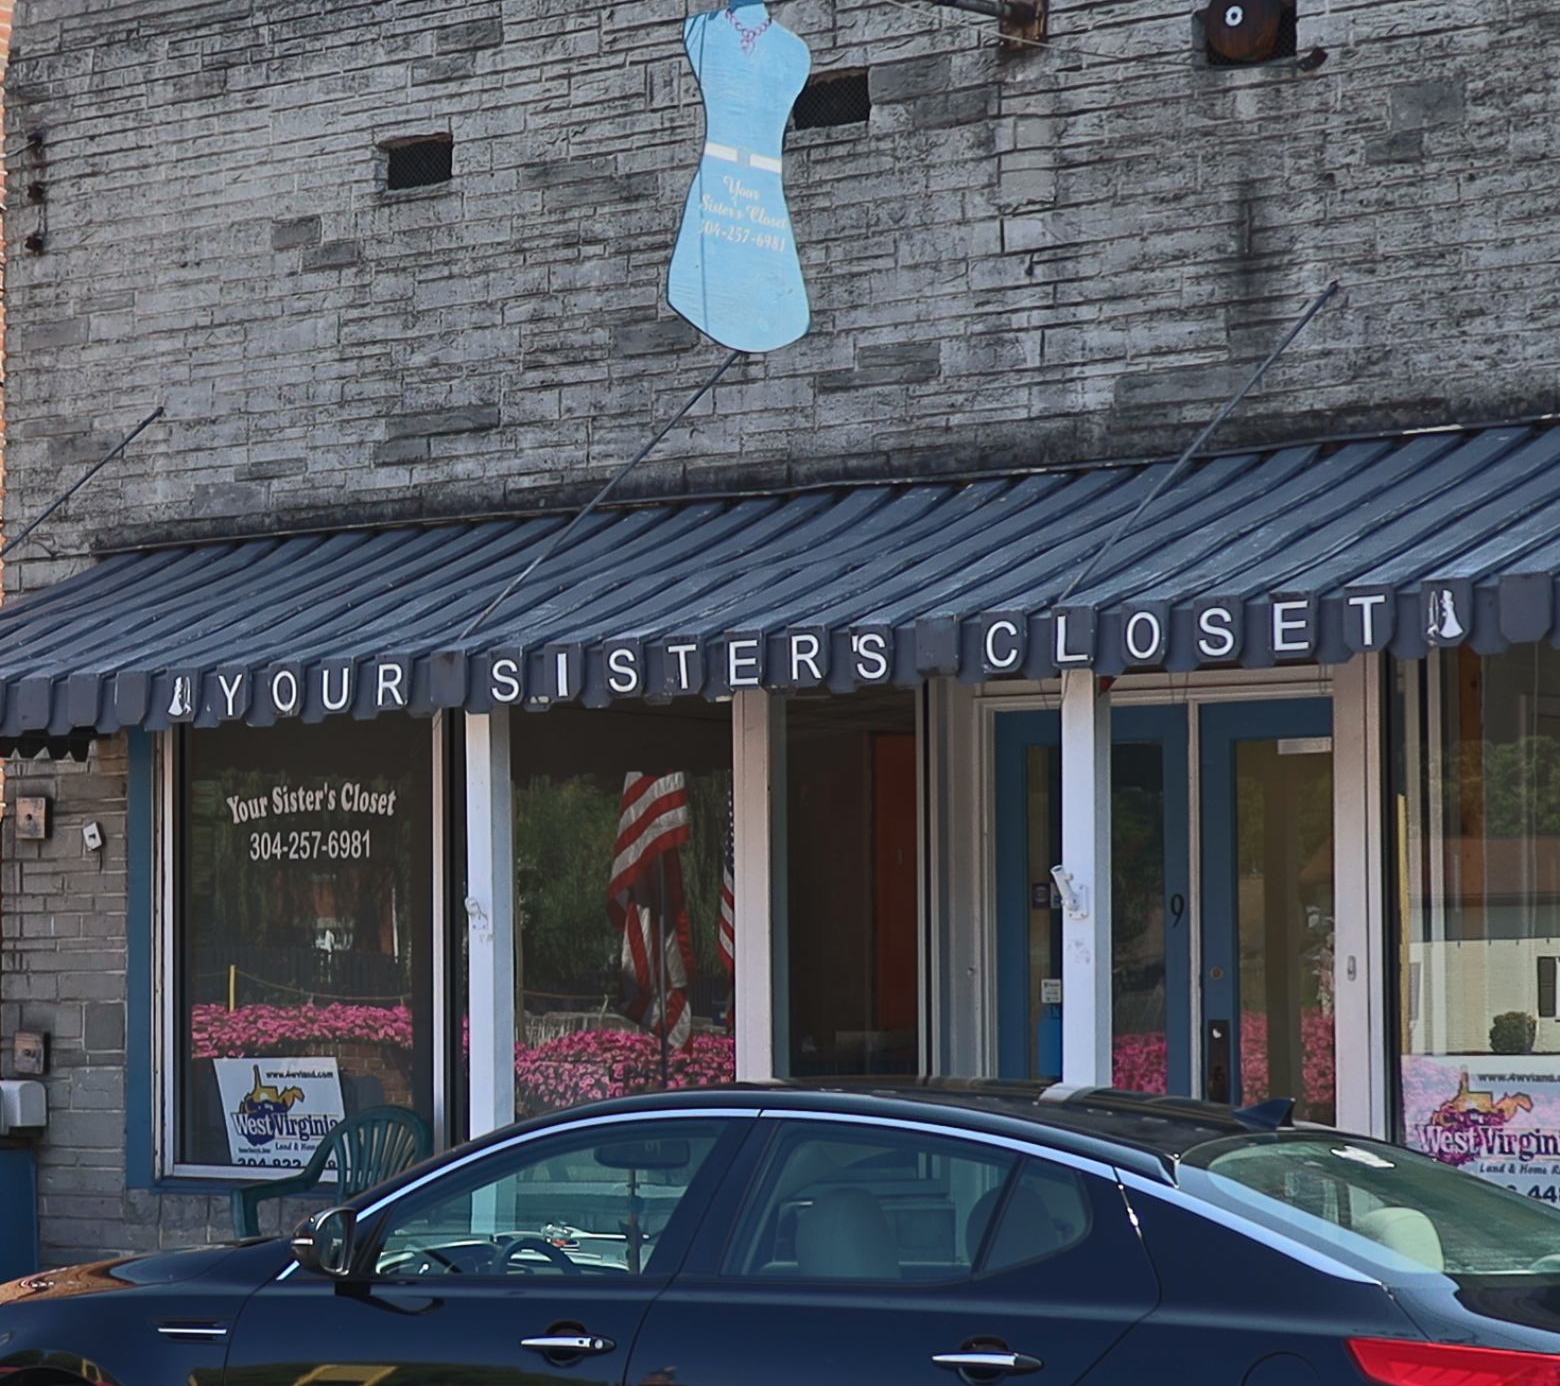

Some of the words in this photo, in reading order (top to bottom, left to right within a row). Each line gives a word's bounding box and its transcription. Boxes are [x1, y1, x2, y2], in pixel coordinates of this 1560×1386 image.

[723, 175, 761, 201] Your
[745, 204, 791, 230] Closet
[218, 663, 405, 717] YOUR
[490, 633, 888, 704] SISTER'S
[985, 593, 1386, 669] CLOSET
[226, 795, 269, 825] Your
[271, 781, 337, 815] Sister's
[340, 781, 397, 817] Closet
[249, 829, 371, 861] 304-257-6981
[1170, 893, 1185, 928] 9
[229, 1111, 275, 1137] West
[1416, 1124, 1480, 1155] West
[1480, 1163, 1506, 1174] Land
[1508, 1163, 1517, 1175] &
[1519, 1164, 1548, 1176] Home
